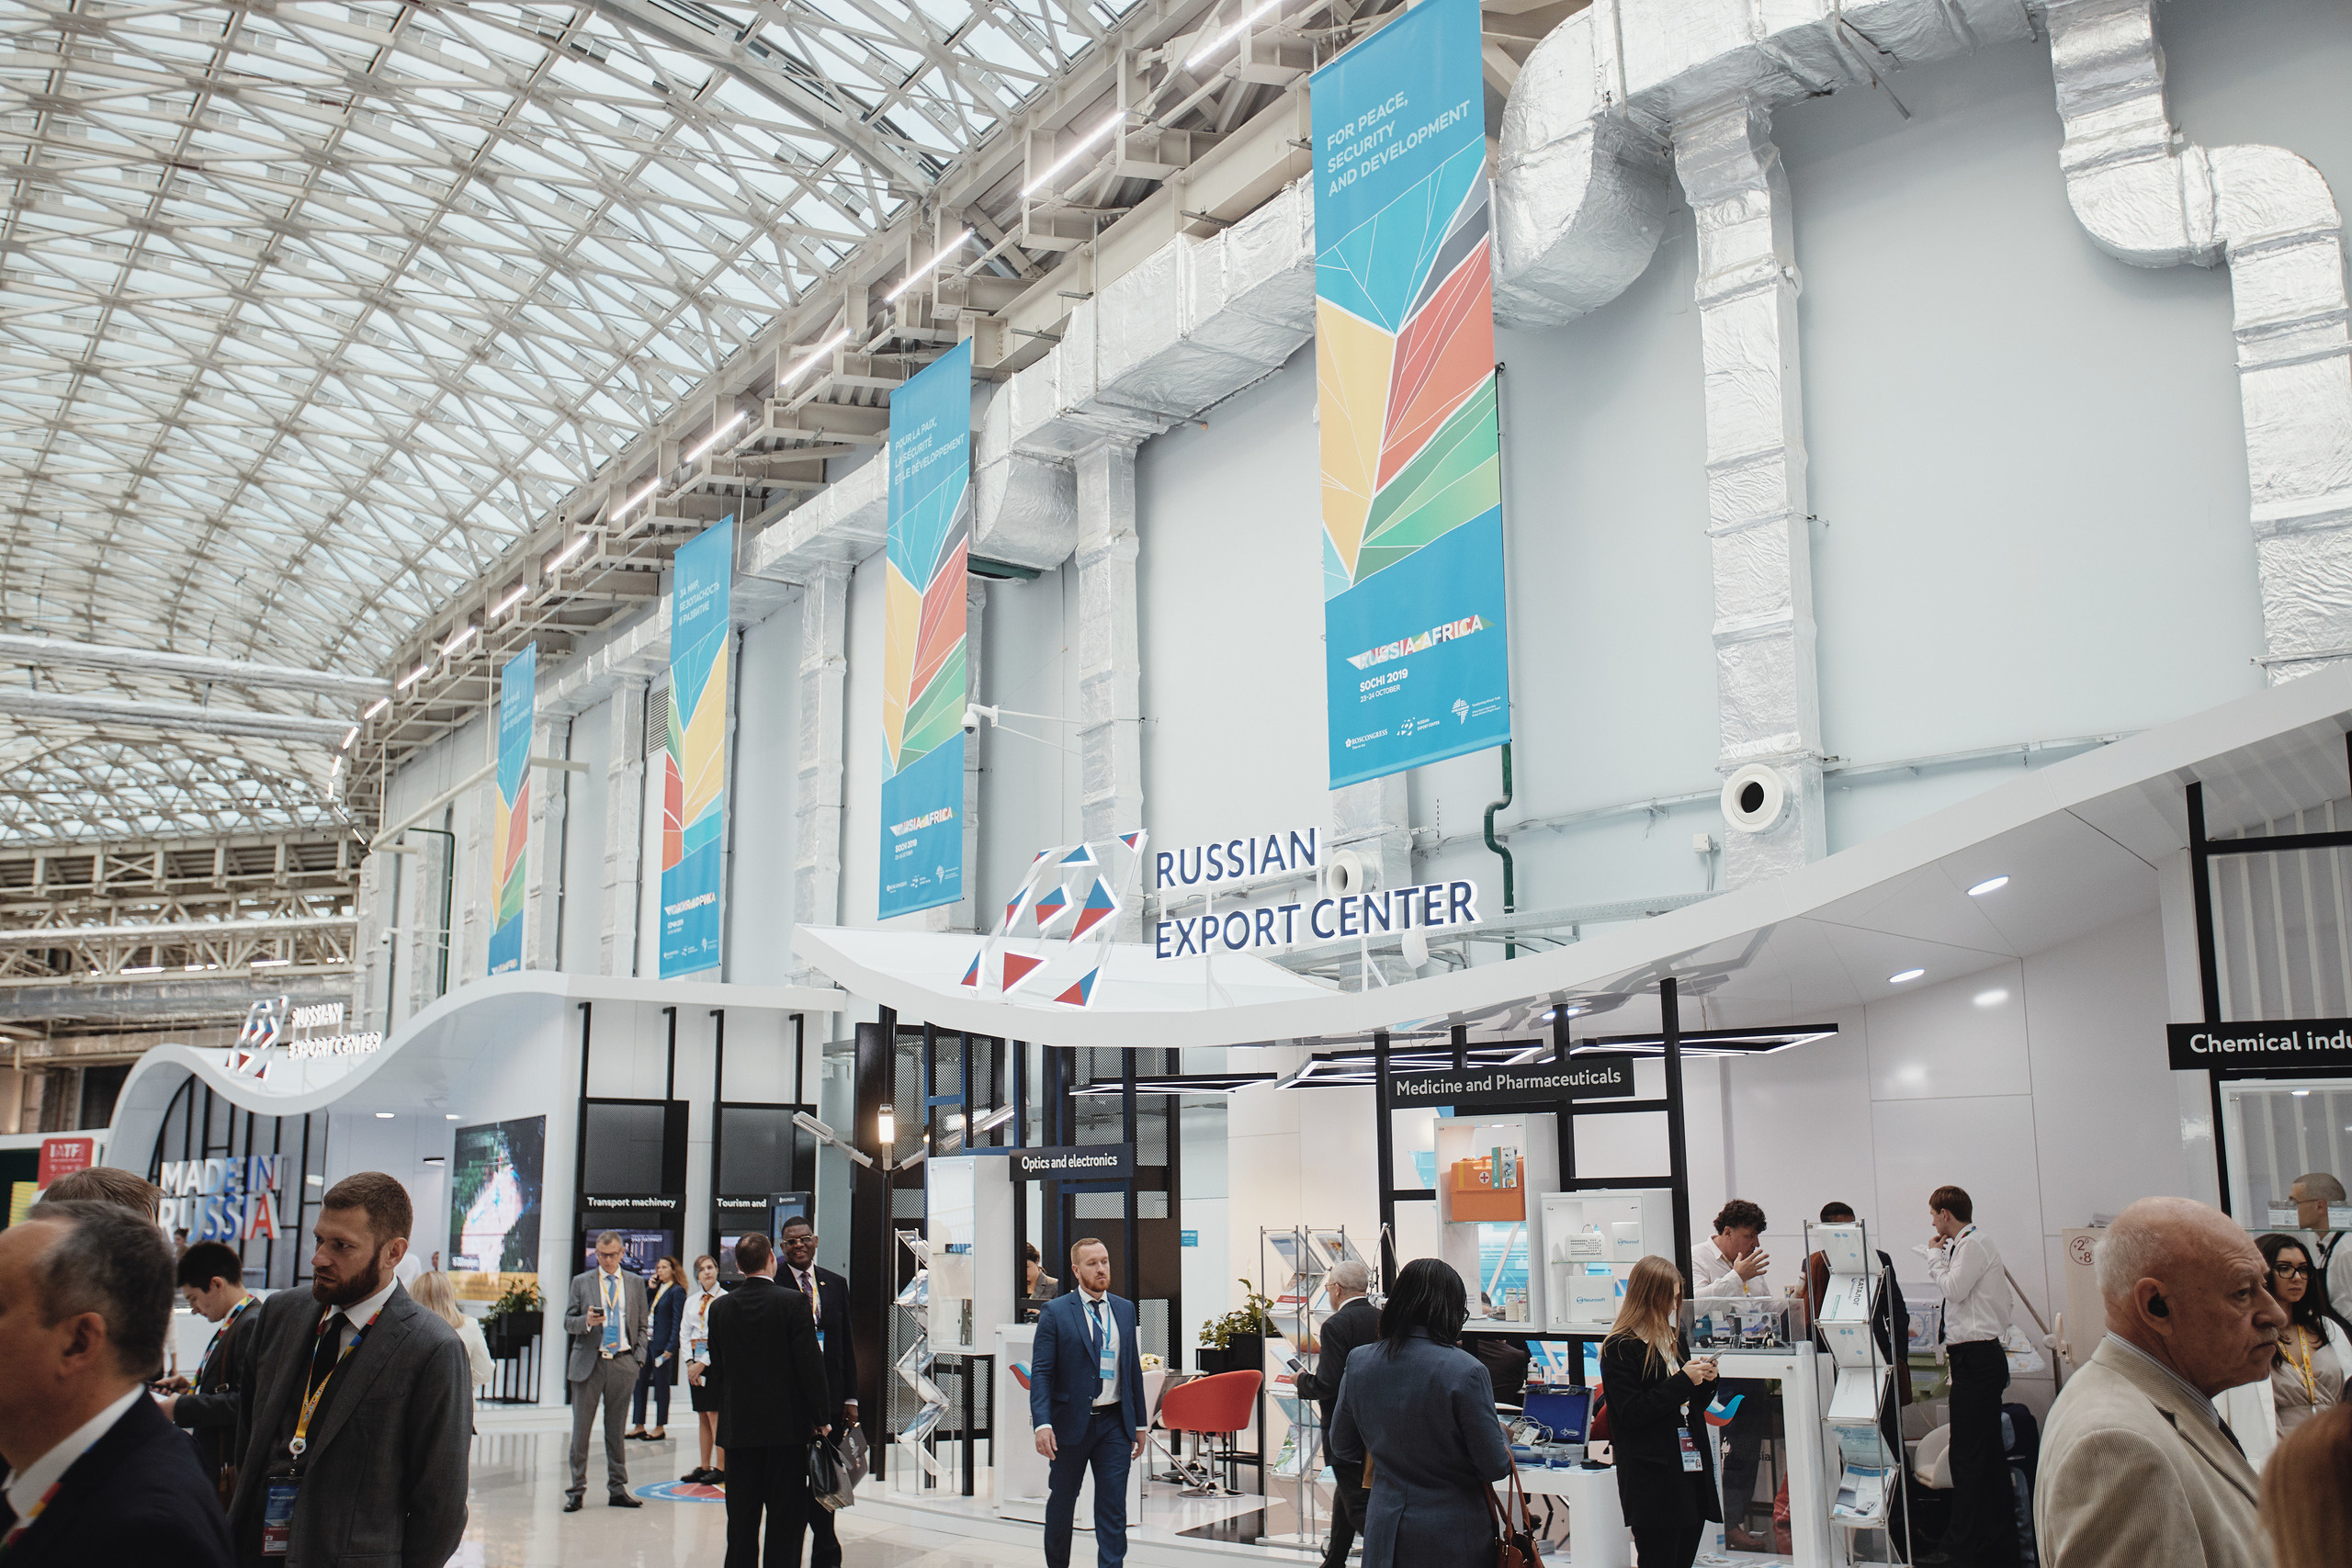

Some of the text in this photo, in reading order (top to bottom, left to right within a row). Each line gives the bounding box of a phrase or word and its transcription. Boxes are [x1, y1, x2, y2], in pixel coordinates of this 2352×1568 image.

[1327, 91, 1408, 151] FOR PEACE,
[1327, 120, 1396, 174] SECURITY
[1329, 99, 1470, 197] AND DEVELOPMENT
[895, 433, 911, 451] POUR
[911, 427, 921, 440] LA
[902, 434, 933, 463] SÉCURITÉ
[910, 433, 965, 476] DÉVELOPPEMENT
[1360, 668, 1408, 693] SOCHI 2019
[1375, 684, 1401, 698] OCTOBER
[1351, 728, 1388, 745] ROSCONGRESS
[1156, 827, 1317, 889] RUSSIAN
[1156, 881, 1476, 959] EXPORT CENTER
[291, 1002, 344, 1029] RUSSIAN
[288, 1031, 382, 1060] EXPORT CENTER
[2189, 1031, 2302, 1054] Chemical
[1396, 1066, 1622, 1096] Medicine and Pharmaceuticals
[160, 1154, 277, 1197] MADE IN
[1021, 1152, 1118, 1173] Optics and electronics
[587, 1196, 676, 1209] Transport machinery
[717, 1197, 751, 1208] Tourism
[752, 1198, 767, 1208] and
[157, 1193, 276, 1244] RUSSIA
[1851, 1277, 1865, 1306] КАТАЛОГ
